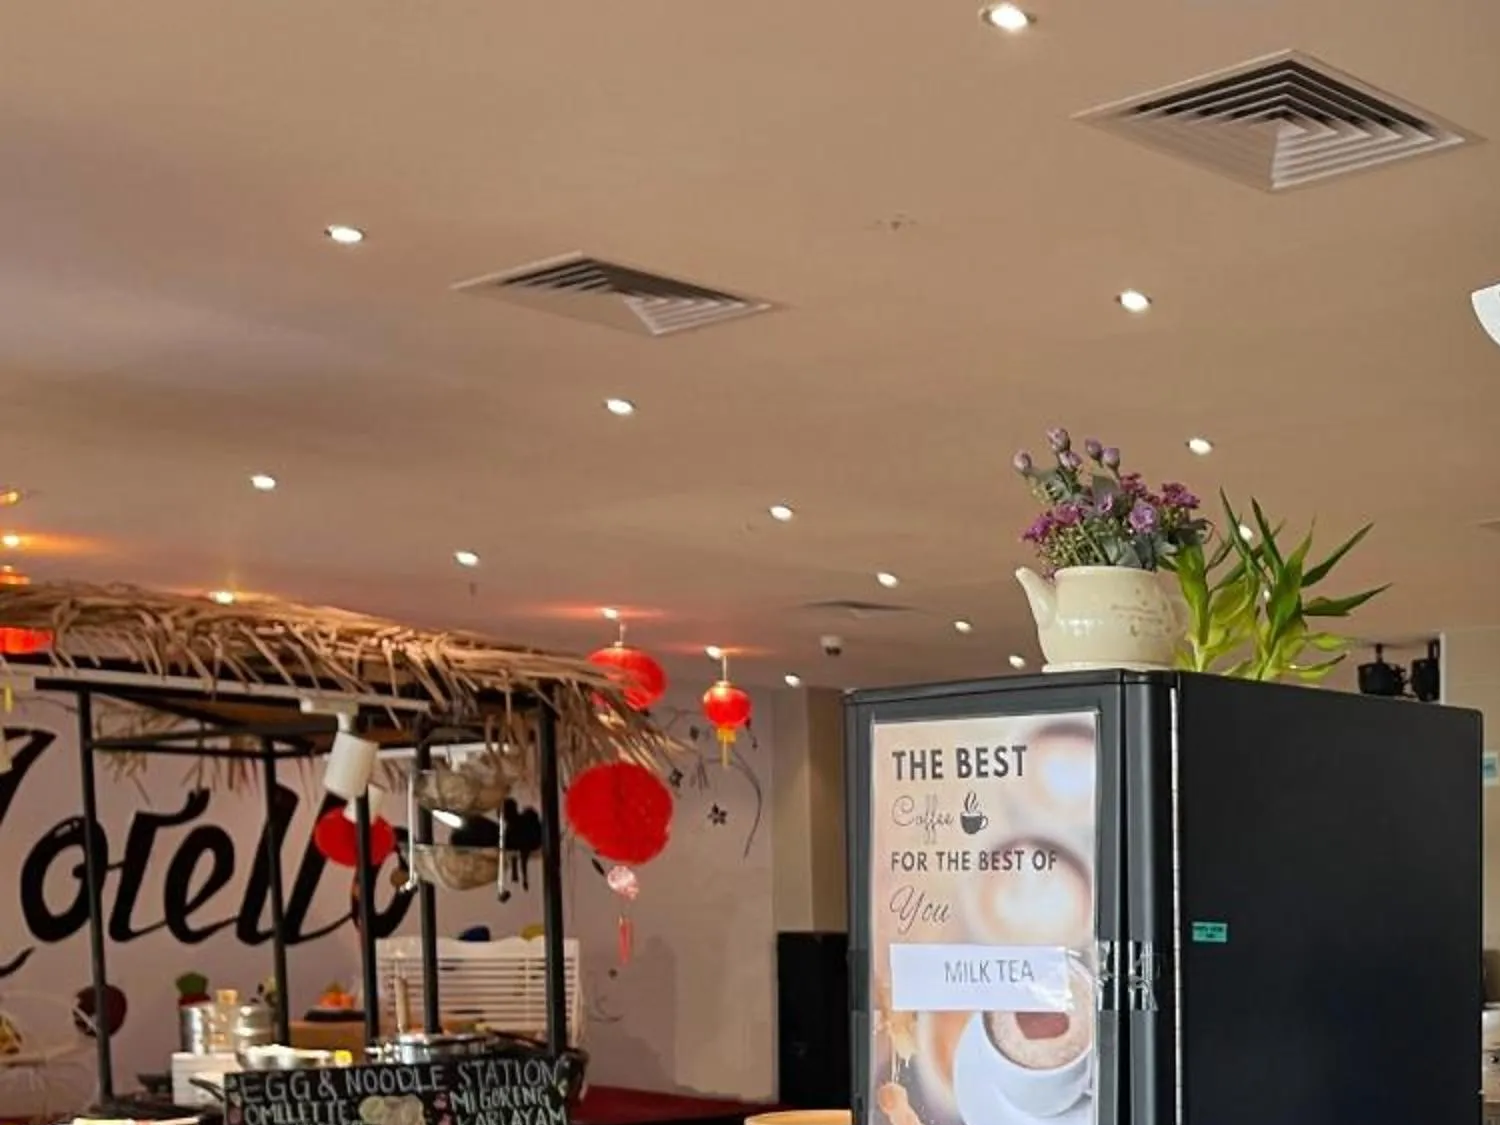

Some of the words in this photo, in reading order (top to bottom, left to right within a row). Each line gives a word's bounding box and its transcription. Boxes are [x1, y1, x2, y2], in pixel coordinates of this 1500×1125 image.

[892, 749, 944, 781] THE
[956, 745, 1028, 779] BEST
[891, 793, 955, 845] Coffee
[891, 851, 928, 872] FOR
[936, 851, 970, 872] THE
[978, 850, 1025, 871] BEST
[1031, 850, 1057, 871] OF
[889, 884, 950, 936] You
[944, 960, 991, 984] MILK
[996, 959, 1035, 983] TEA
[240, 1070, 310, 1102] EGG
[317, 1069, 338, 1101] &
[345, 1065, 447, 1095] NOODLE
[457, 1058, 561, 1089] STATION
[449, 1088, 477, 1114] MI
